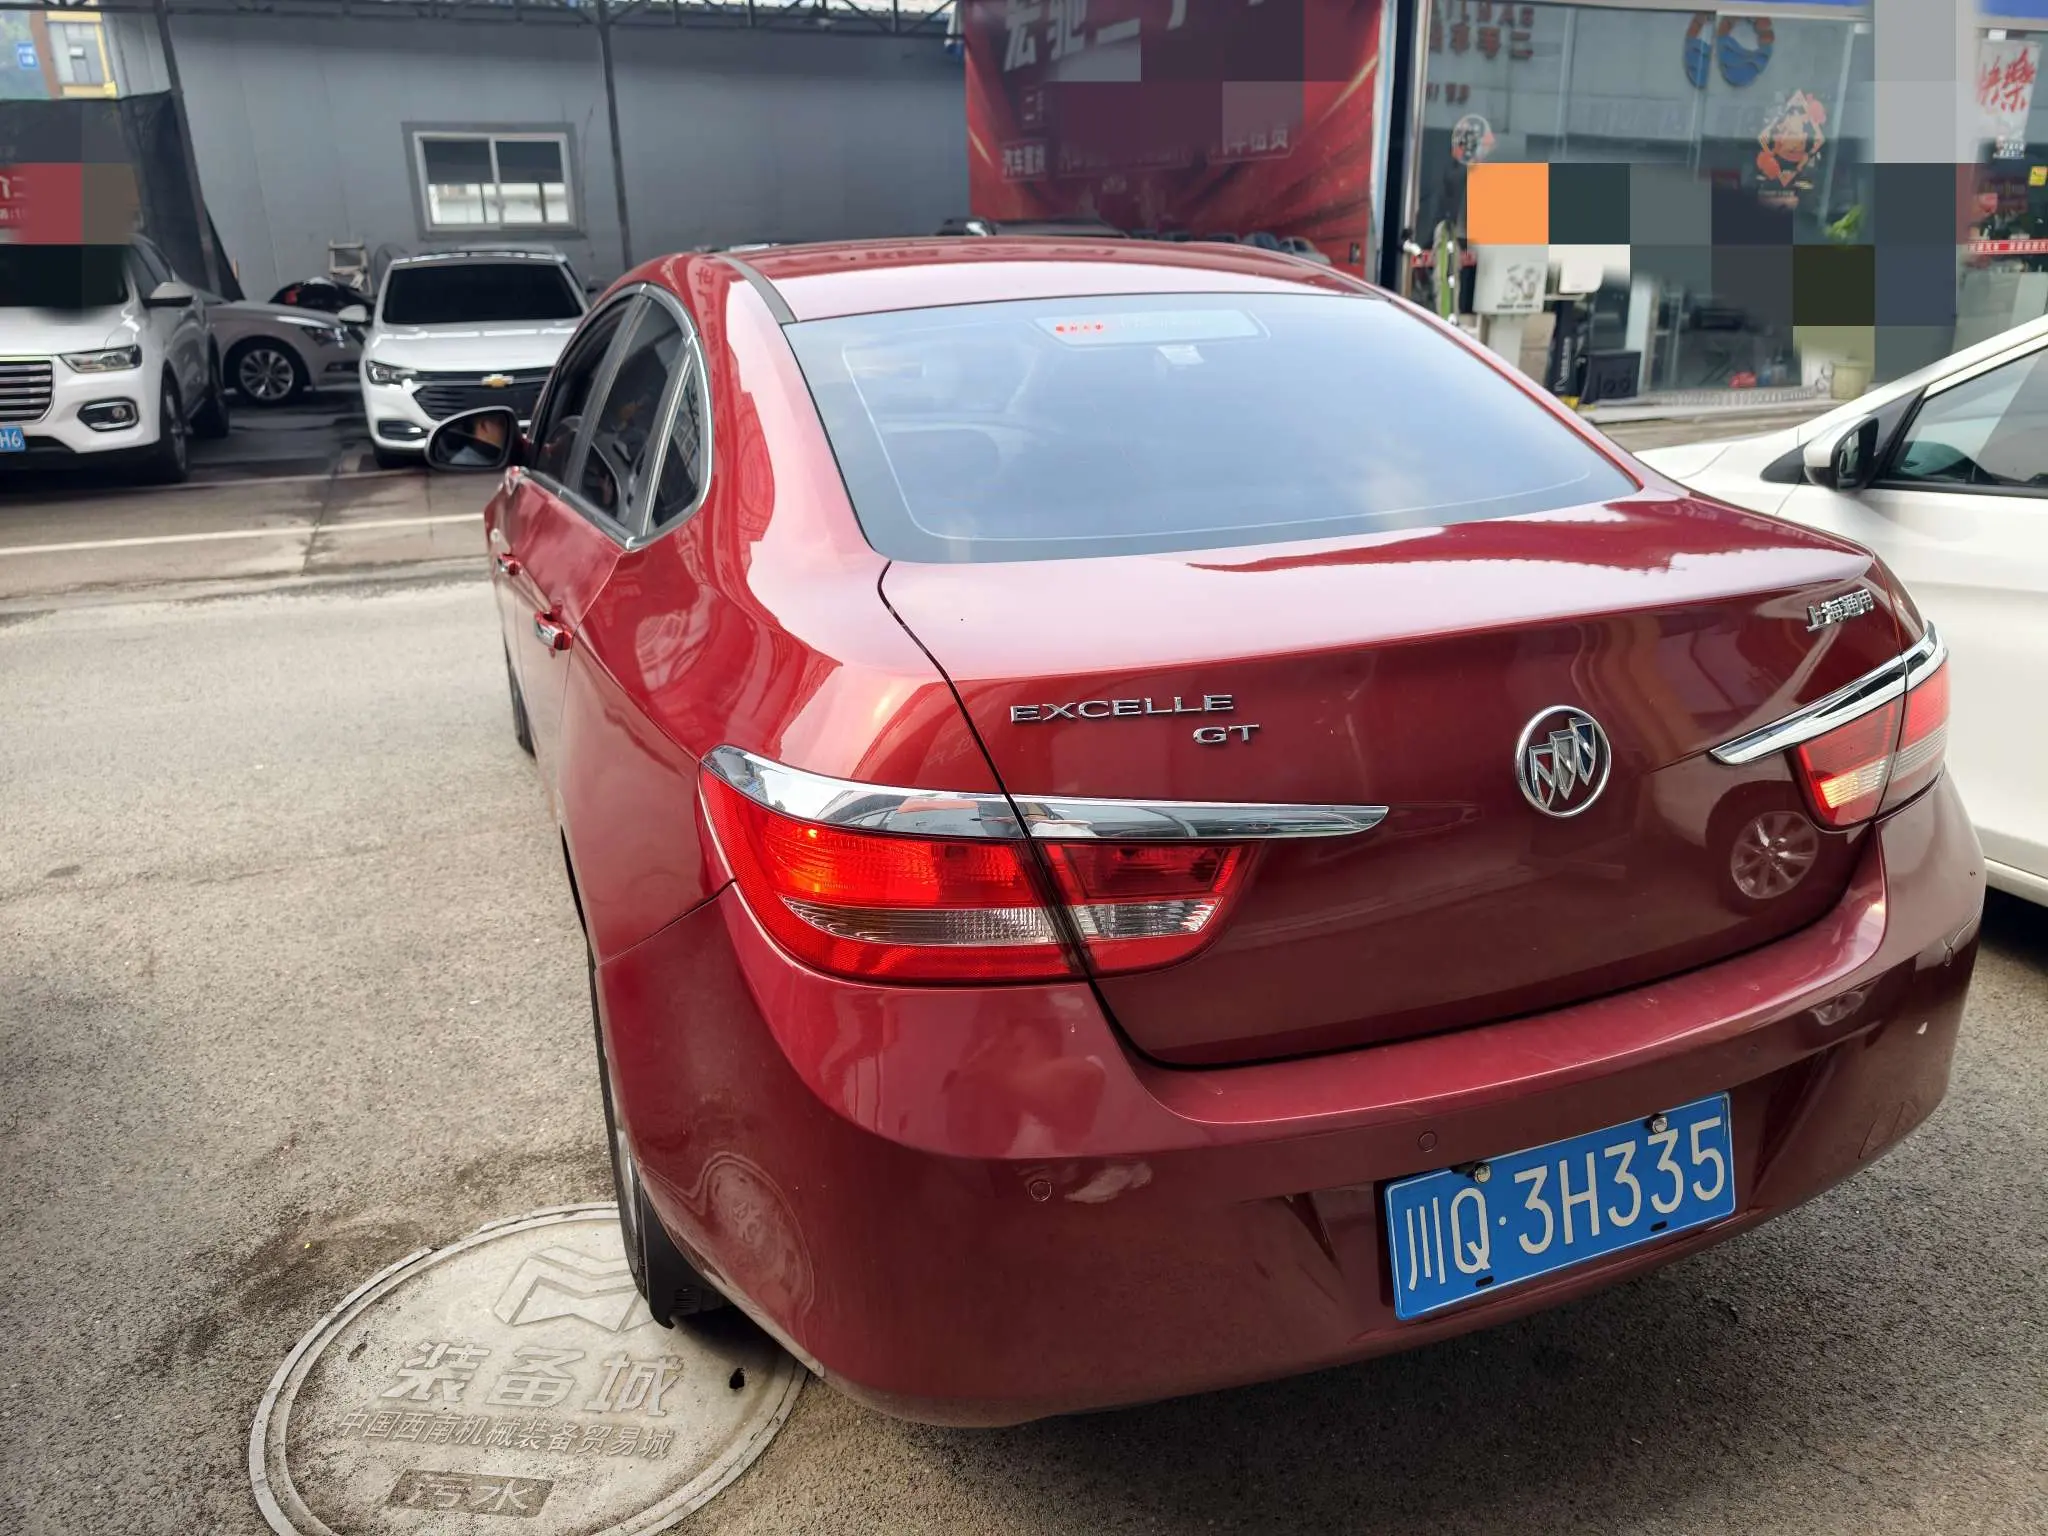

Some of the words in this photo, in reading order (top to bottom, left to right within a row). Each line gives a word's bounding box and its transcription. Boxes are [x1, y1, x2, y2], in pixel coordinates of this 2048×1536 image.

[1010, 694, 1235, 724] EXCELLE
[1193, 724, 1260, 744] GT
[1406, 1116, 1726, 1292] 川Q·3H335
[381, 1341, 686, 1418] 装备城
[337, 1408, 676, 1460] 中国西南机械装备贸易城
[404, 1473, 530, 1513] 污水
